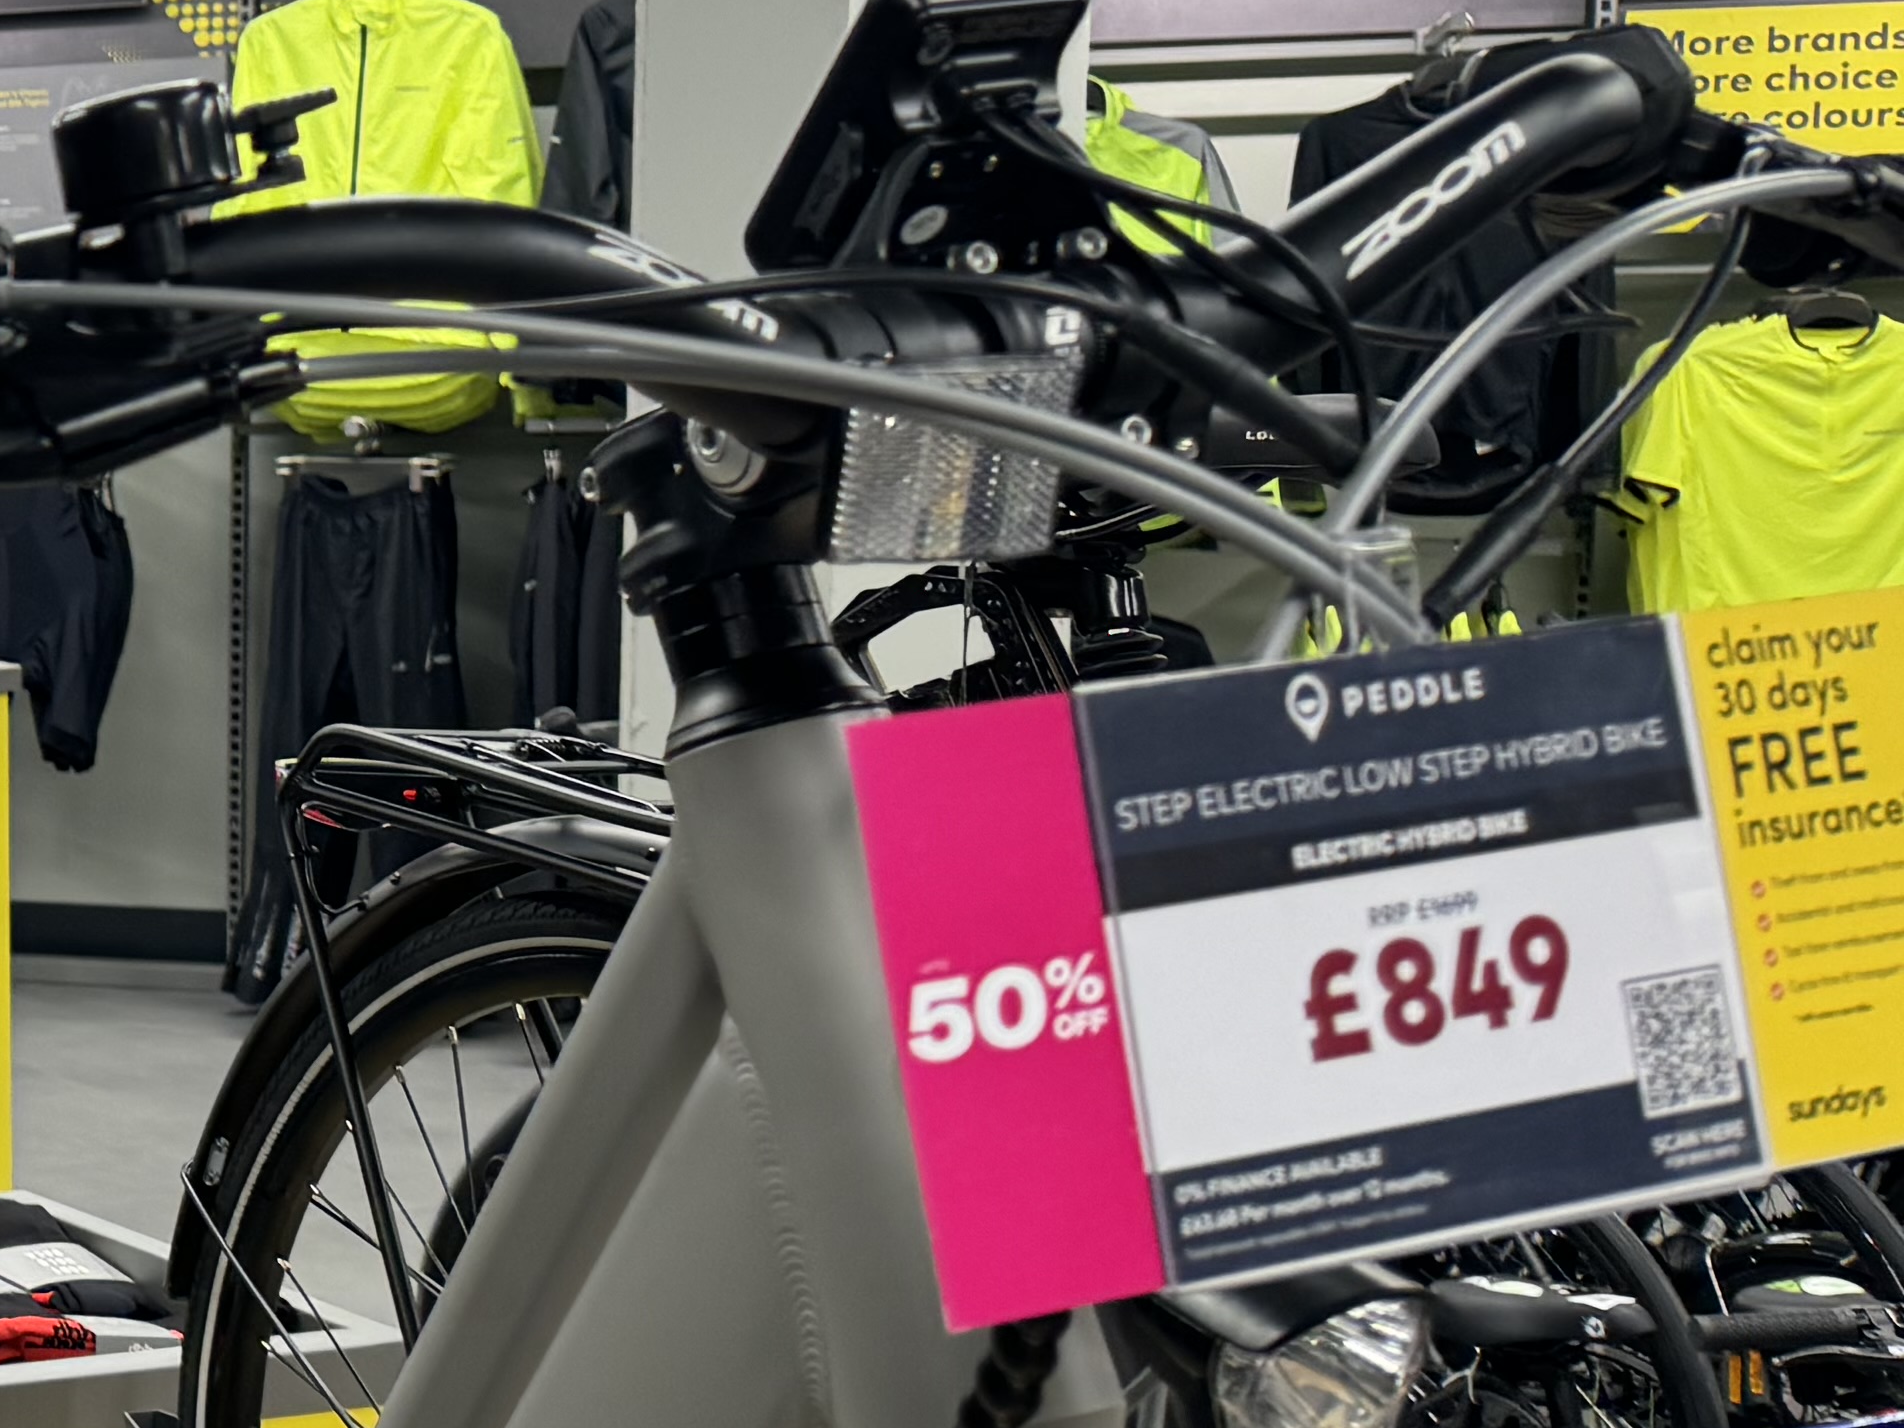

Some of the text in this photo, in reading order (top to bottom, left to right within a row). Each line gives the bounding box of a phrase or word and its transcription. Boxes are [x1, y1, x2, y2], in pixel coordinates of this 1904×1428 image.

[1693, 61, 1898, 94] ore choice
[1706, 620, 1880, 670] claim your
[1341, 666, 1485, 719] PEDDLE
[1714, 669, 1849, 718] 30 days
[1114, 715, 1669, 833] STEP ELECTRIC LOW STEP HYBRID BIKE
[1727, 720, 1870, 799] FREE
[1292, 806, 1530, 870] ELECTRIC HYBRID BIKE
[907, 948, 1106, 1065] 50%
[1303, 913, 1571, 1064] £849
[1052, 1004, 1110, 1041] OFF
